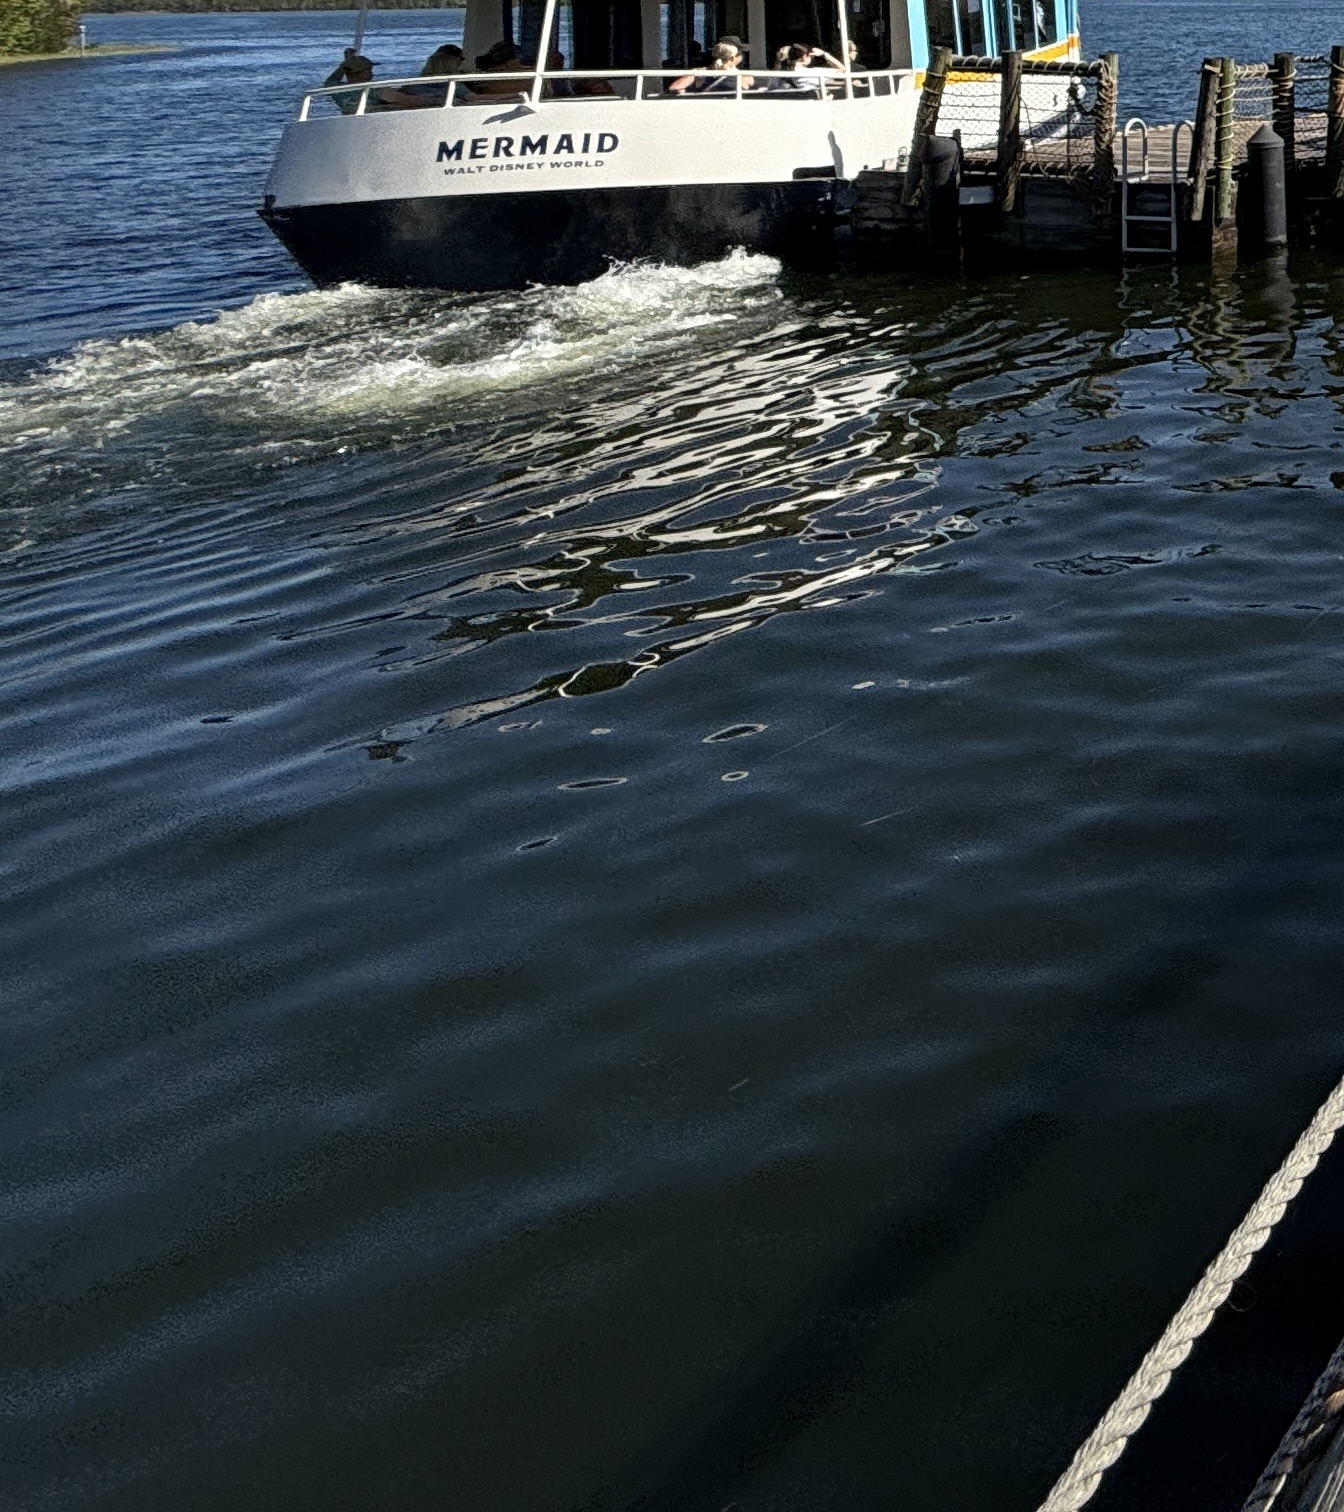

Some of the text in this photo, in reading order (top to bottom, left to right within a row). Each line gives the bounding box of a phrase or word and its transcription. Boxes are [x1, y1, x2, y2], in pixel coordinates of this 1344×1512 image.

[434, 132, 619, 163] MERMAID
[444, 160, 605, 175] WALT DISNEY WORLD
